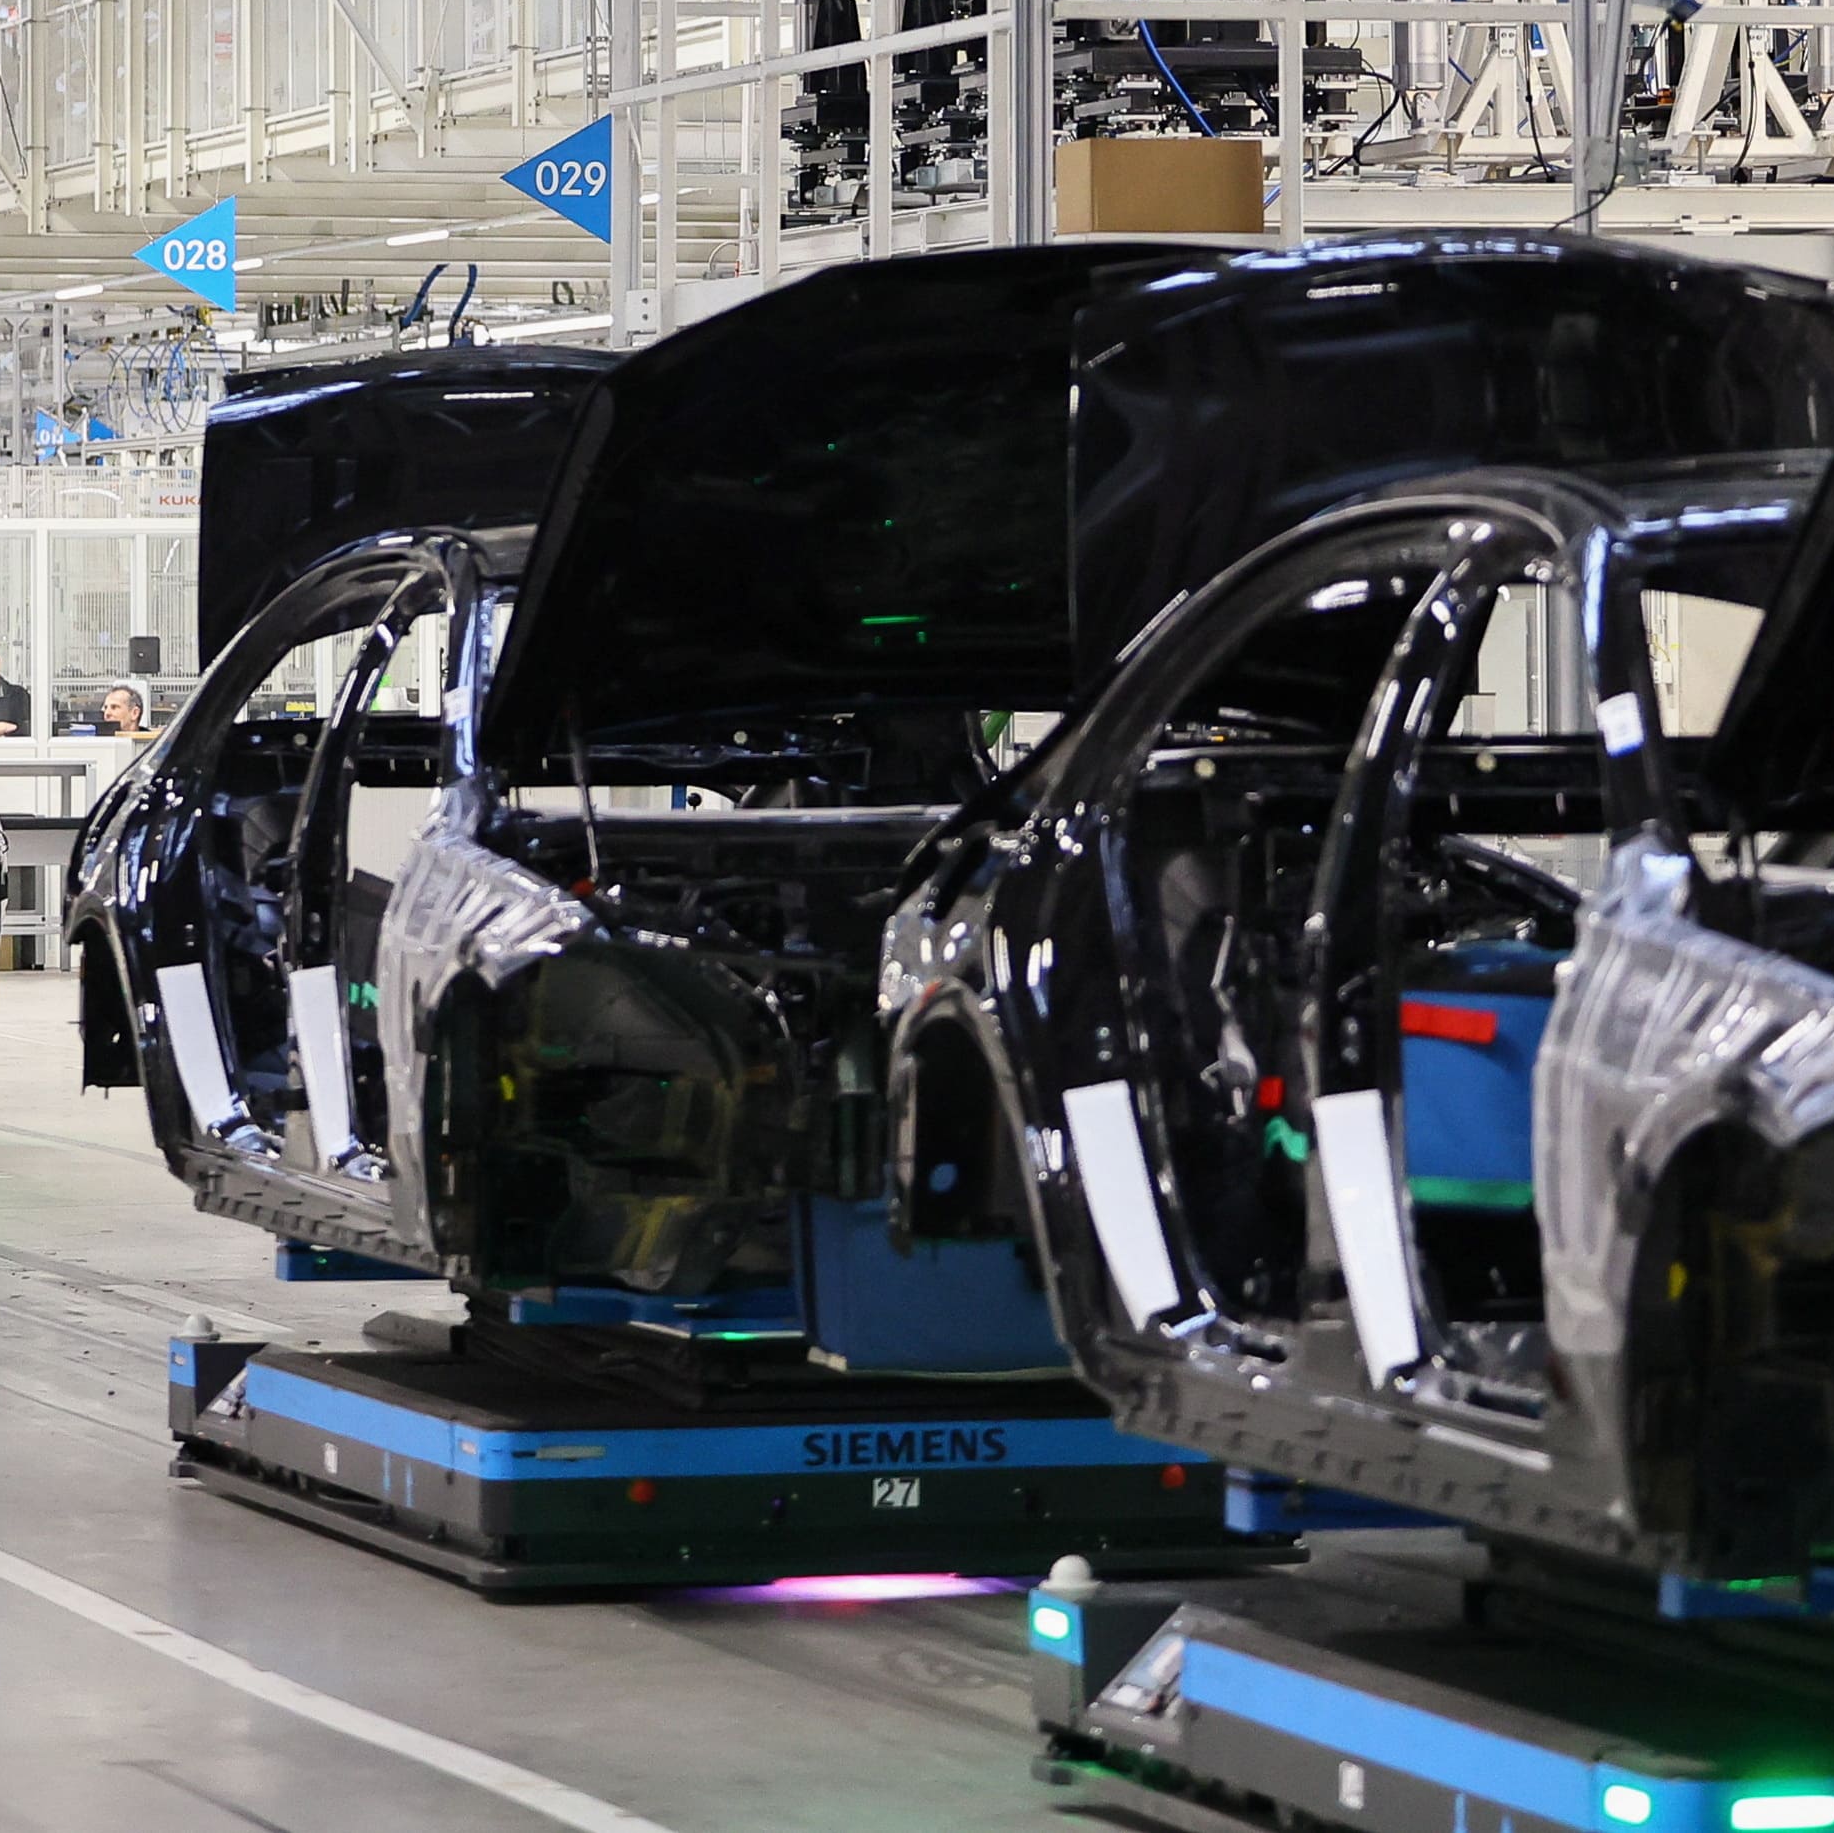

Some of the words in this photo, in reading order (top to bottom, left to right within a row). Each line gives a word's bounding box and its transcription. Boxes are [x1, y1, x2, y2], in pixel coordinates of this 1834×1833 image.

[535, 160, 607, 197] 029
[162, 239, 227, 271] 028
[802, 1427, 1007, 1466] SIEMENS
[876, 1477, 916, 1507] 27
